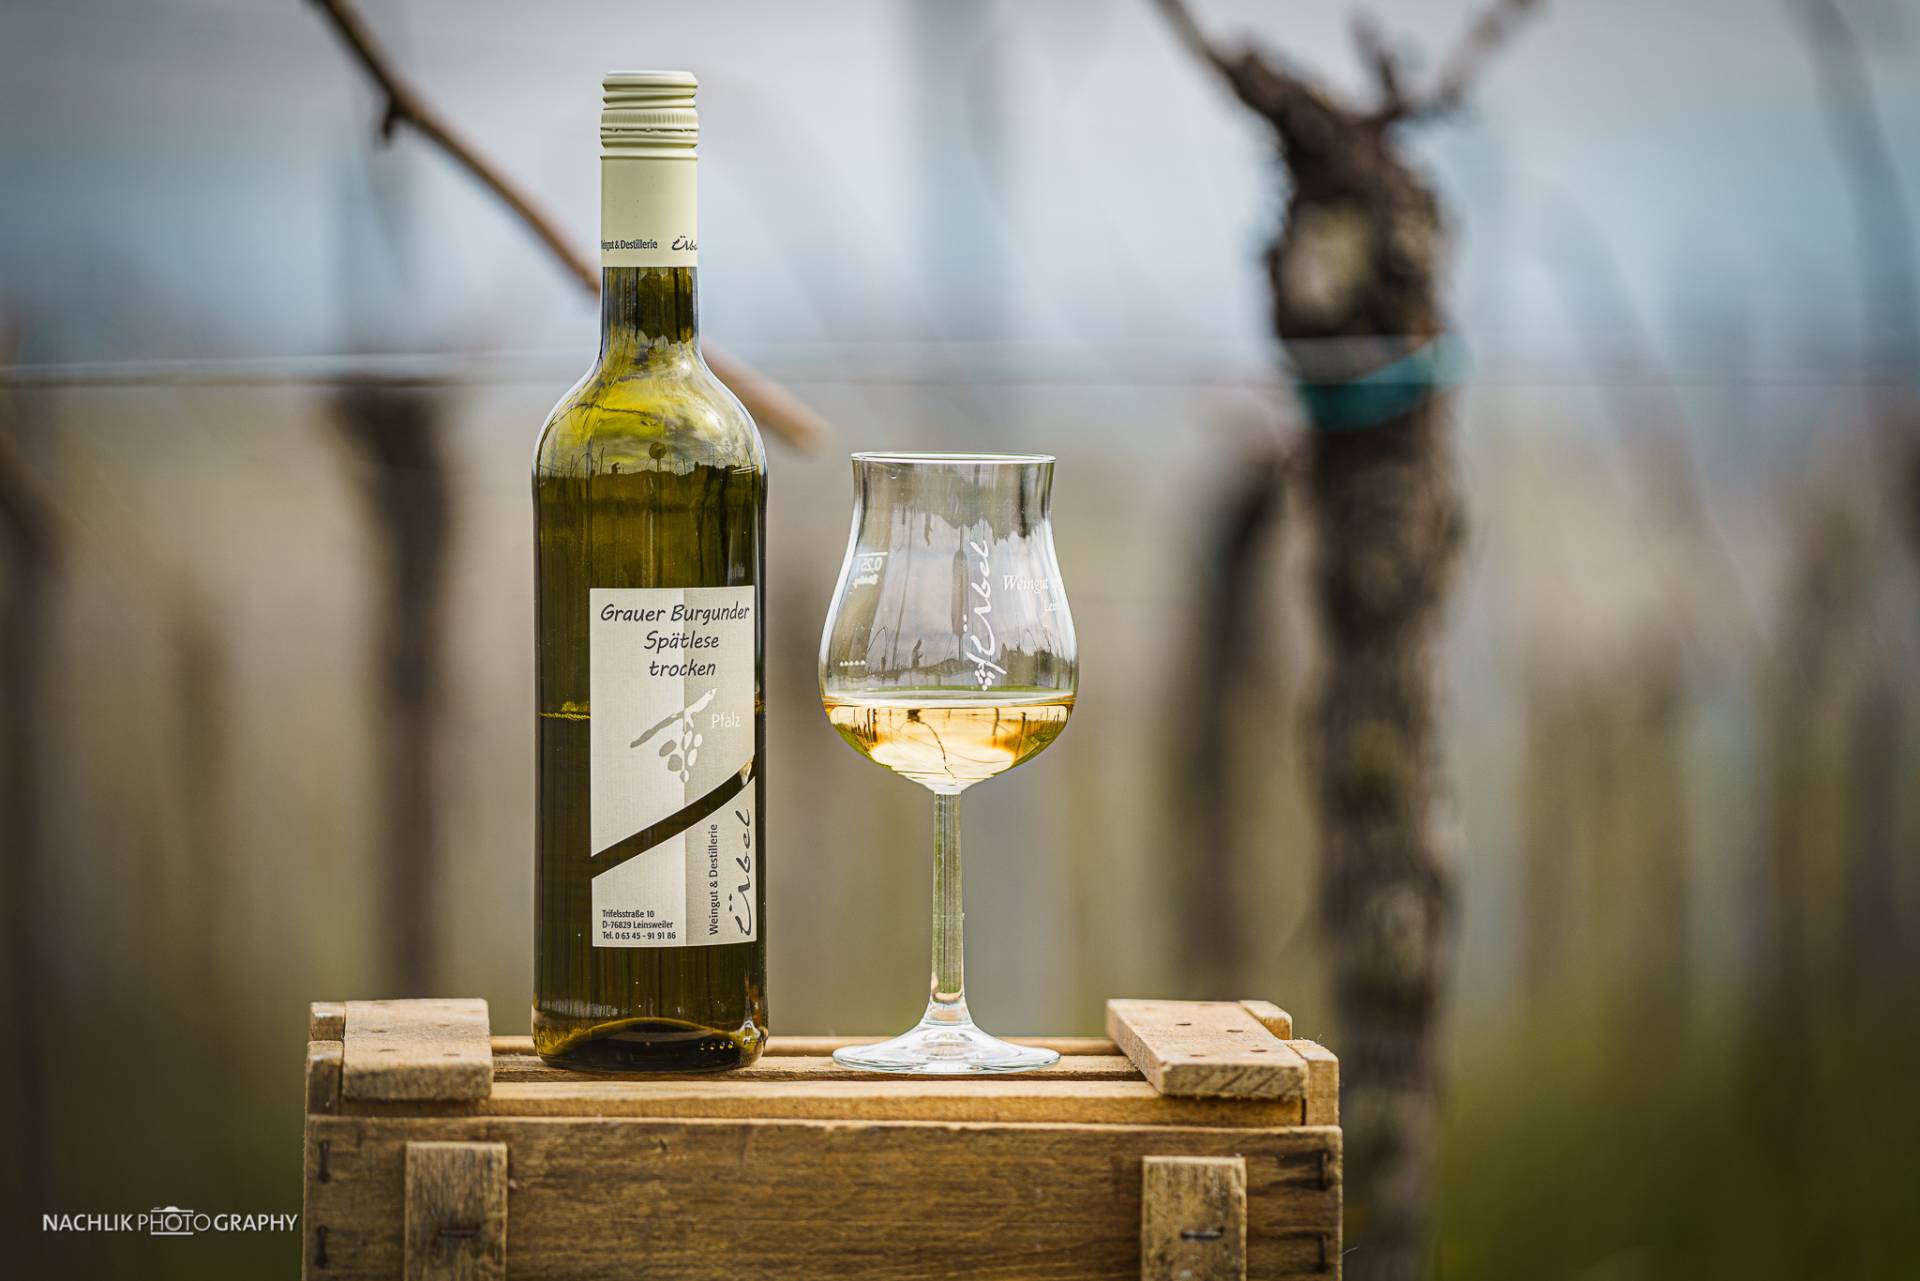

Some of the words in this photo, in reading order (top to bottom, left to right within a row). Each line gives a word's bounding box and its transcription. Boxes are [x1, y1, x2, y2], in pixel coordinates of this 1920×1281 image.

[615, 240, 619, 249] &
[620, 239, 658, 249] Destillerie
[600, 603, 666, 622] Grauer
[670, 600, 750, 626] Burgunder
[643, 630, 720, 654] Spätlese
[649, 658, 716, 677] trocken
[711, 711, 742, 729] Pfalz
[707, 823, 718, 878] Destillerie
[602, 909, 645, 918] Trifelsstraße
[647, 910, 655, 918] 10
[708, 891, 720, 936] Weingut
[602, 920, 632, 929] D-76829
[633, 920, 674, 929] Leinsweiler
[602, 931, 614, 940] Tel.
[615, 932, 620, 940] 0
[621, 932, 630, 940] 63
[632, 932, 641, 940] 45
[647, 932, 655, 940] 91
[657, 932, 665, 940] 91
[667, 931, 676, 940] 86
